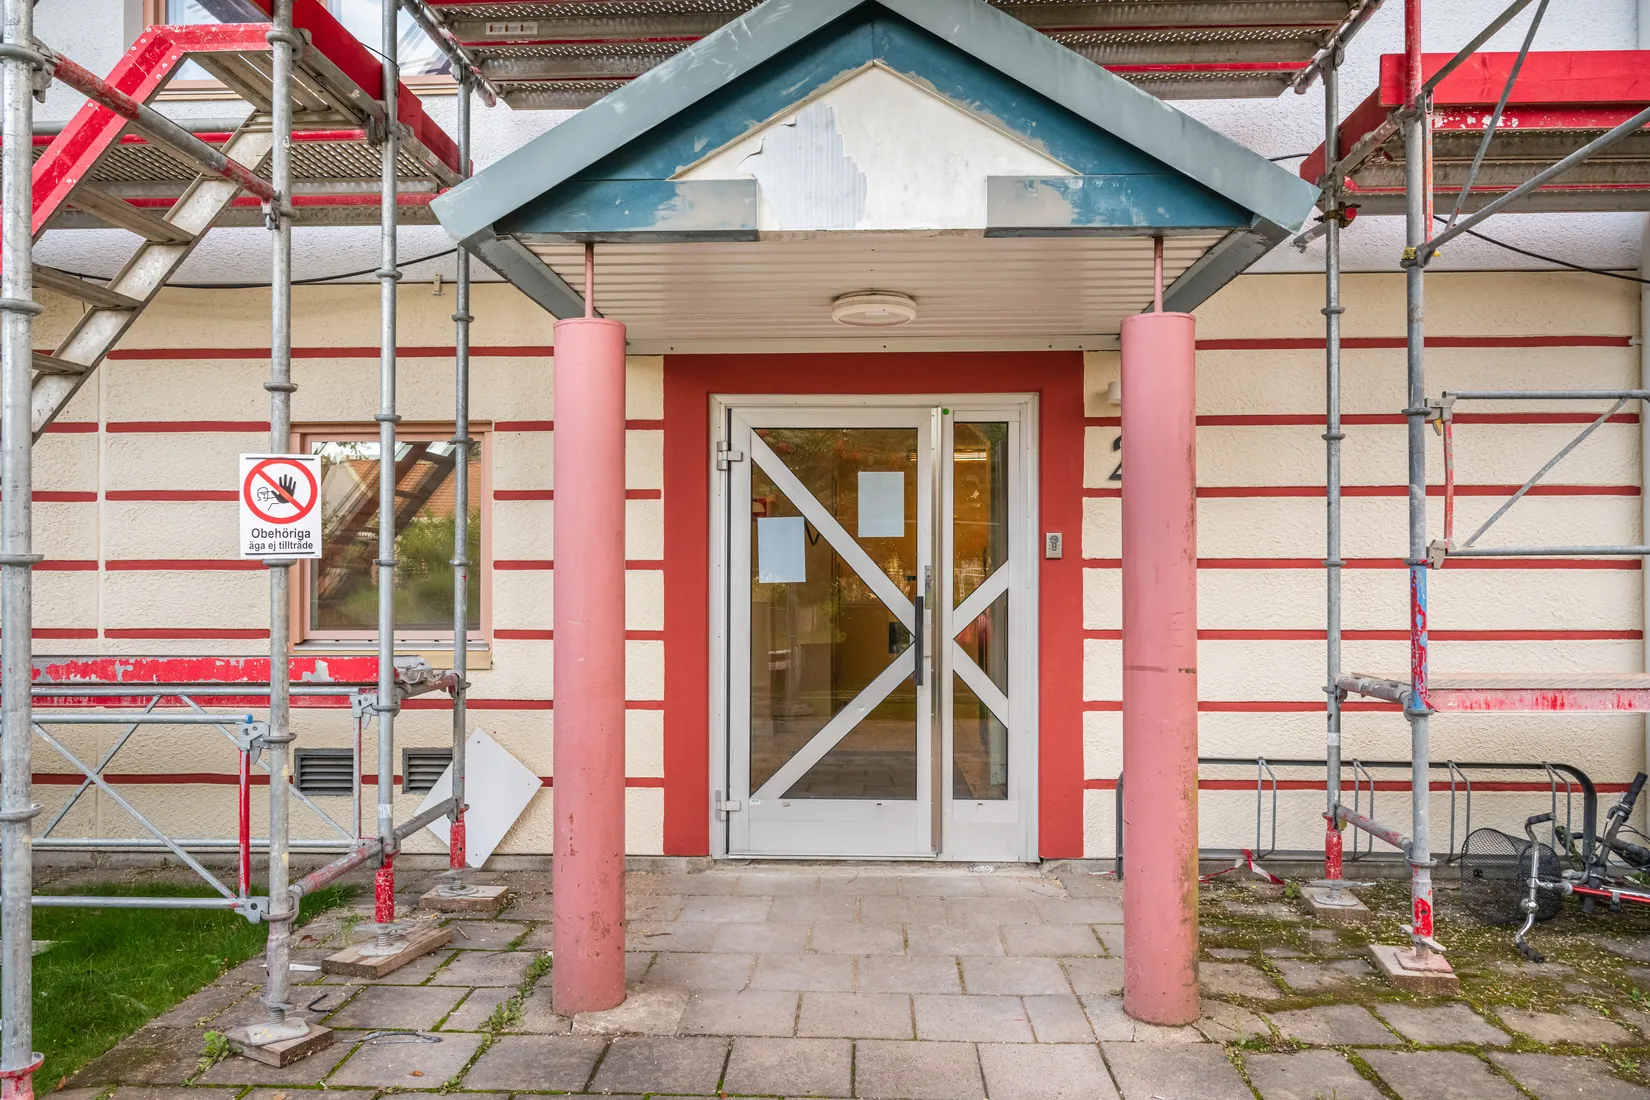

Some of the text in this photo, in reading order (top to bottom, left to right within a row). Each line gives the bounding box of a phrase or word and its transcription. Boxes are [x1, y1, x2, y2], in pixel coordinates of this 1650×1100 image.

[251, 527, 311, 541] Obehöriga
[248, 540, 314, 551] äga ej tillträde
